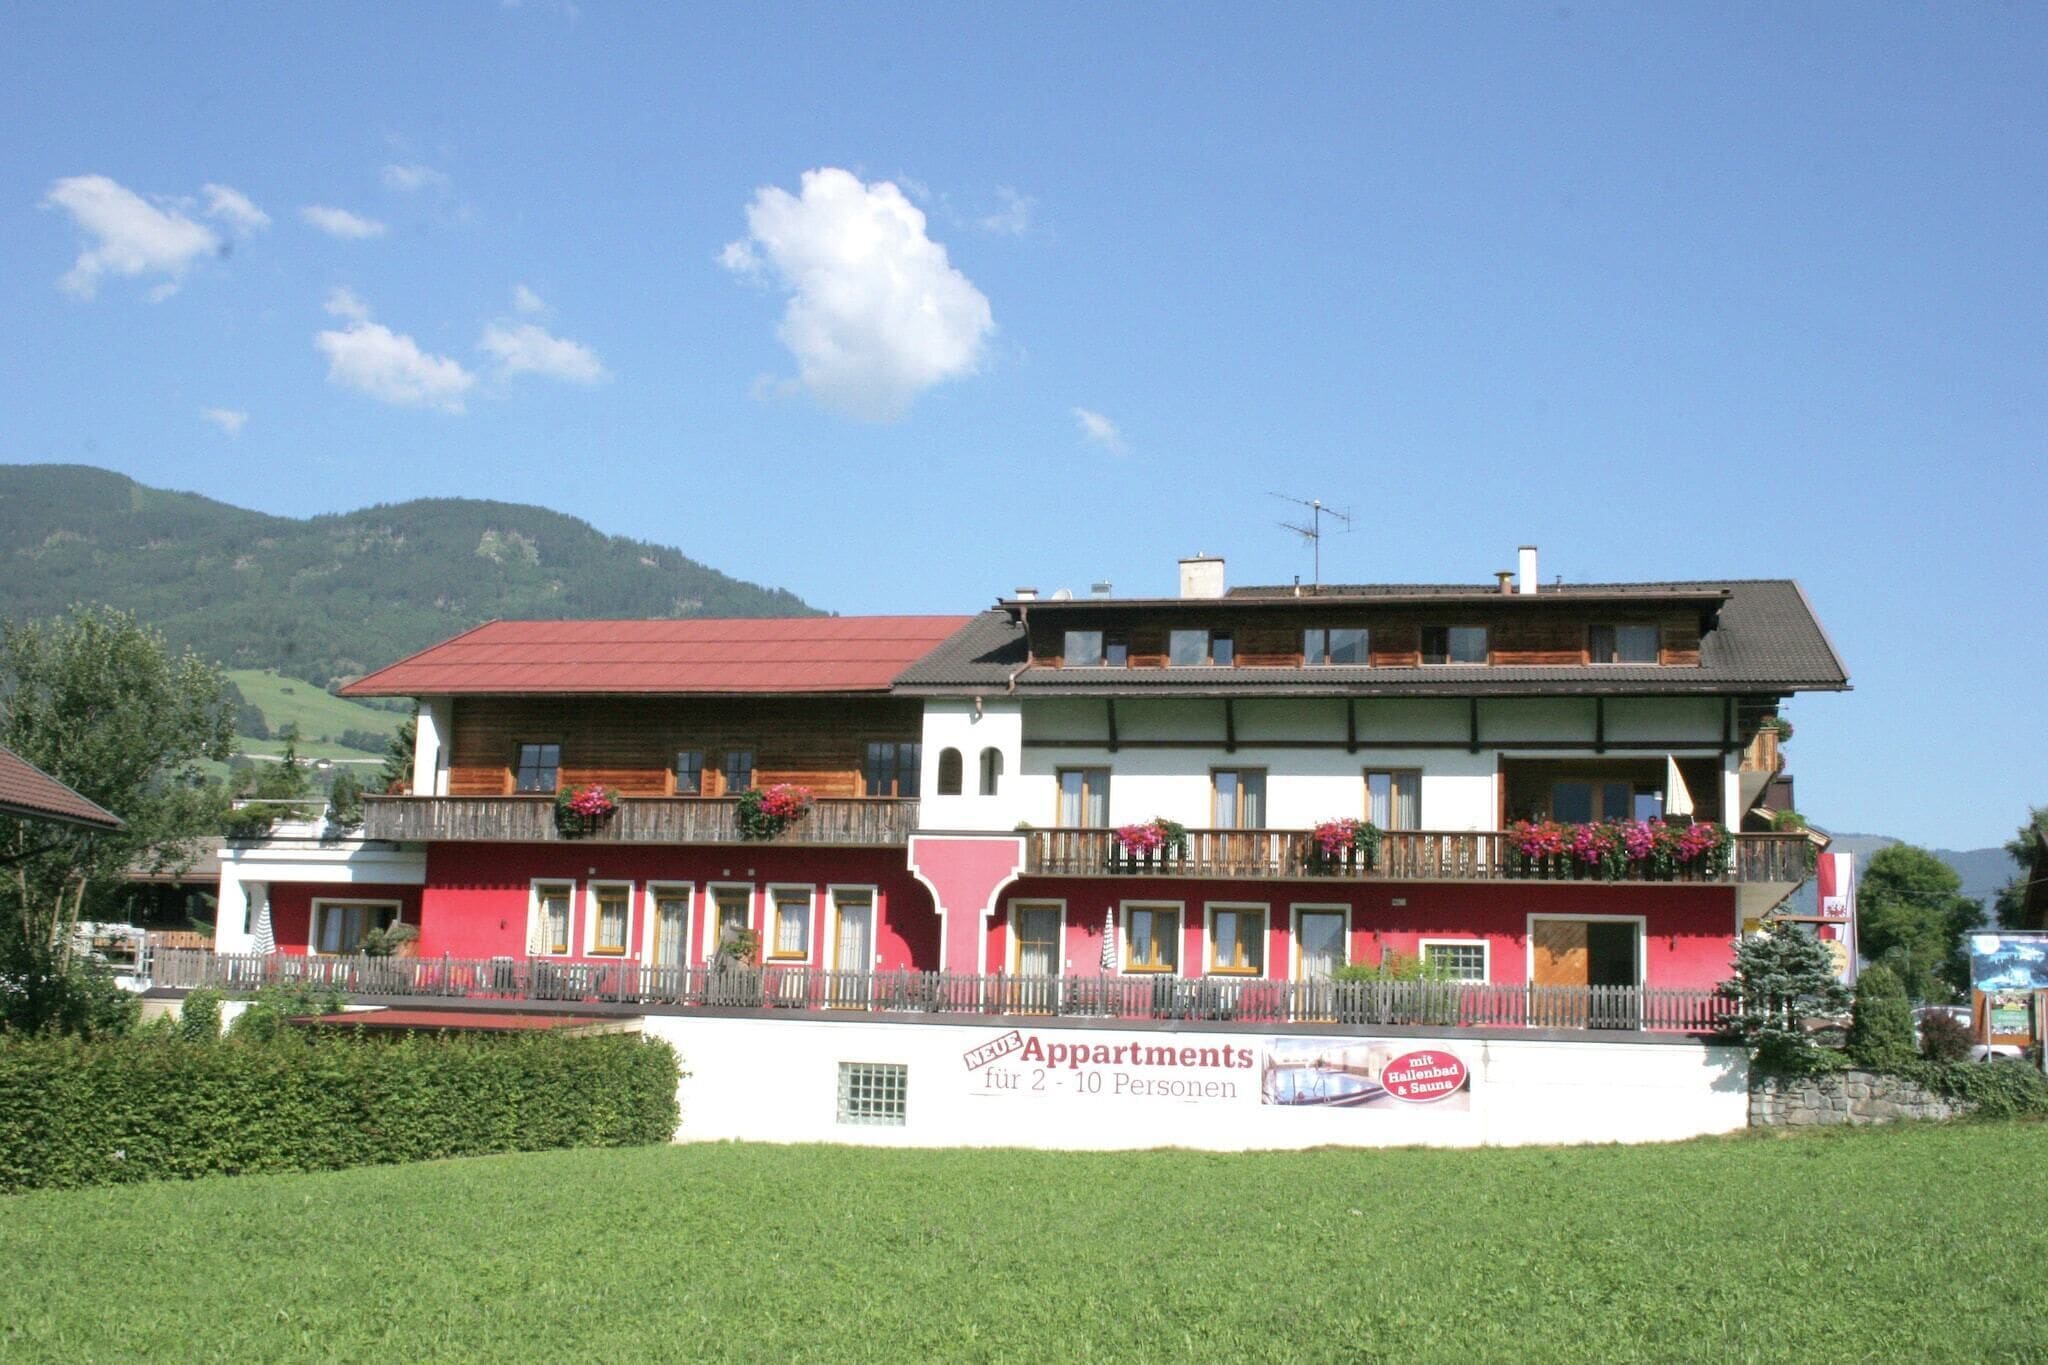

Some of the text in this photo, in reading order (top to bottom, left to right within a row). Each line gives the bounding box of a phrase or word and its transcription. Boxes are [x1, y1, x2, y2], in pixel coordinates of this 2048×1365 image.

[966, 1033, 1021, 1069] NEUE
[1020, 1036, 1254, 1069] Appartments
[1408, 1055, 1434, 1067] mit
[985, 1066, 1021, 1089] für
[1031, 1068, 1046, 1091] 2
[1075, 1071, 1102, 1093] 10
[1113, 1072, 1237, 1098] Personen
[1388, 1064, 1459, 1084] Hallenbad
[1397, 1080, 1454, 1096] & Sauna
